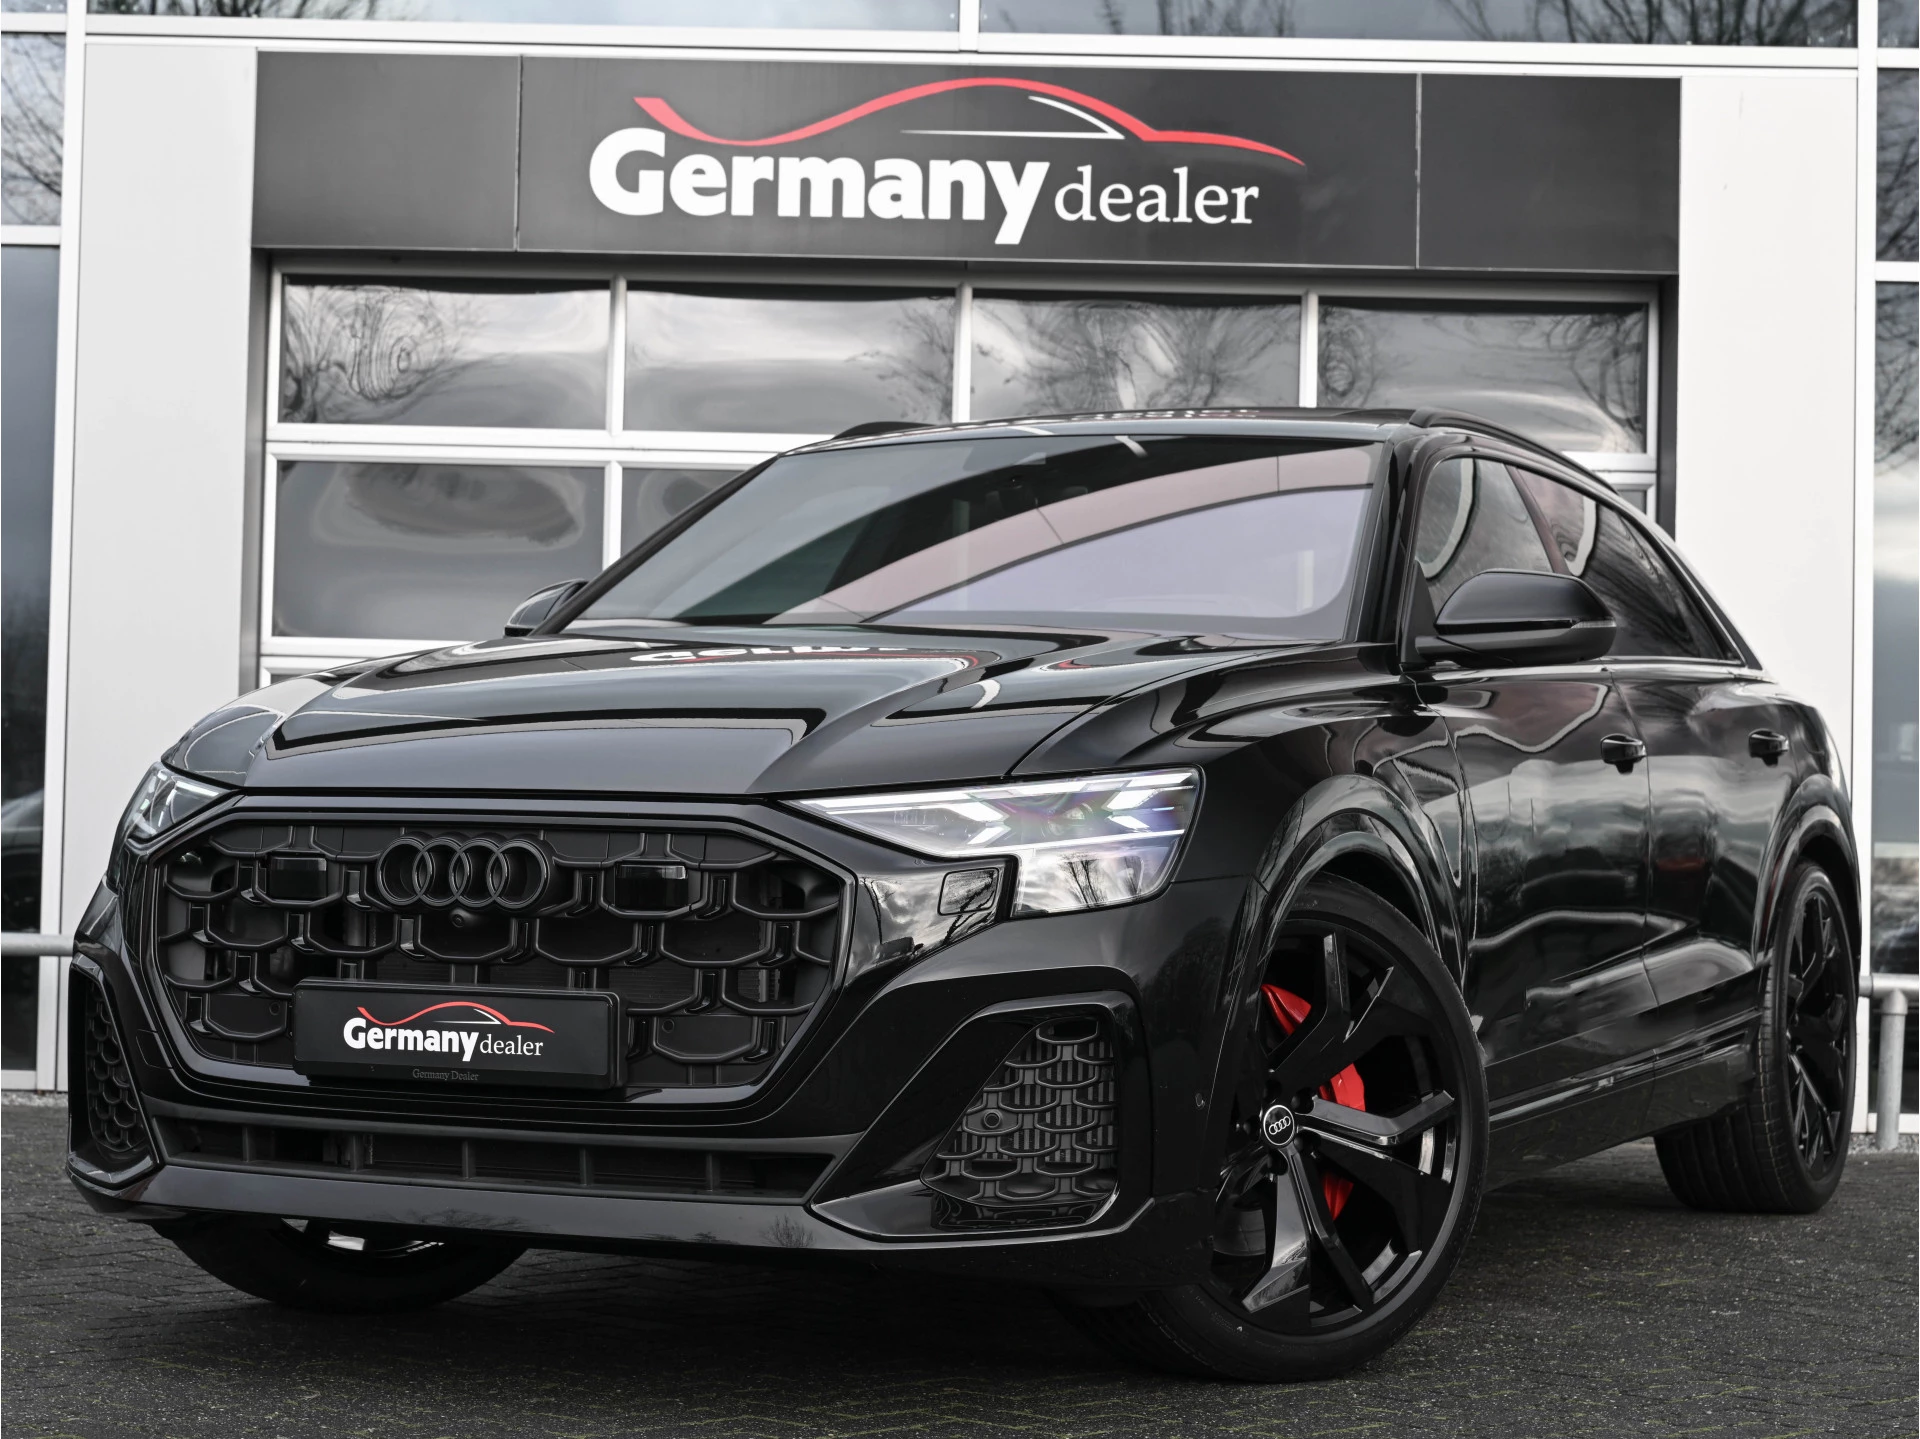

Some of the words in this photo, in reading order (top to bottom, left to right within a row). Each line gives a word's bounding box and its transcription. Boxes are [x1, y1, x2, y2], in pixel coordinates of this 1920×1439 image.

[589, 127, 1050, 245] Germany
[1054, 164, 1259, 224] dealer
[343, 1017, 480, 1062] Germany
[479, 1033, 544, 1056] dealer
[412, 1068, 450, 1081] Germany
[450, 1070, 480, 1081] Dealer
